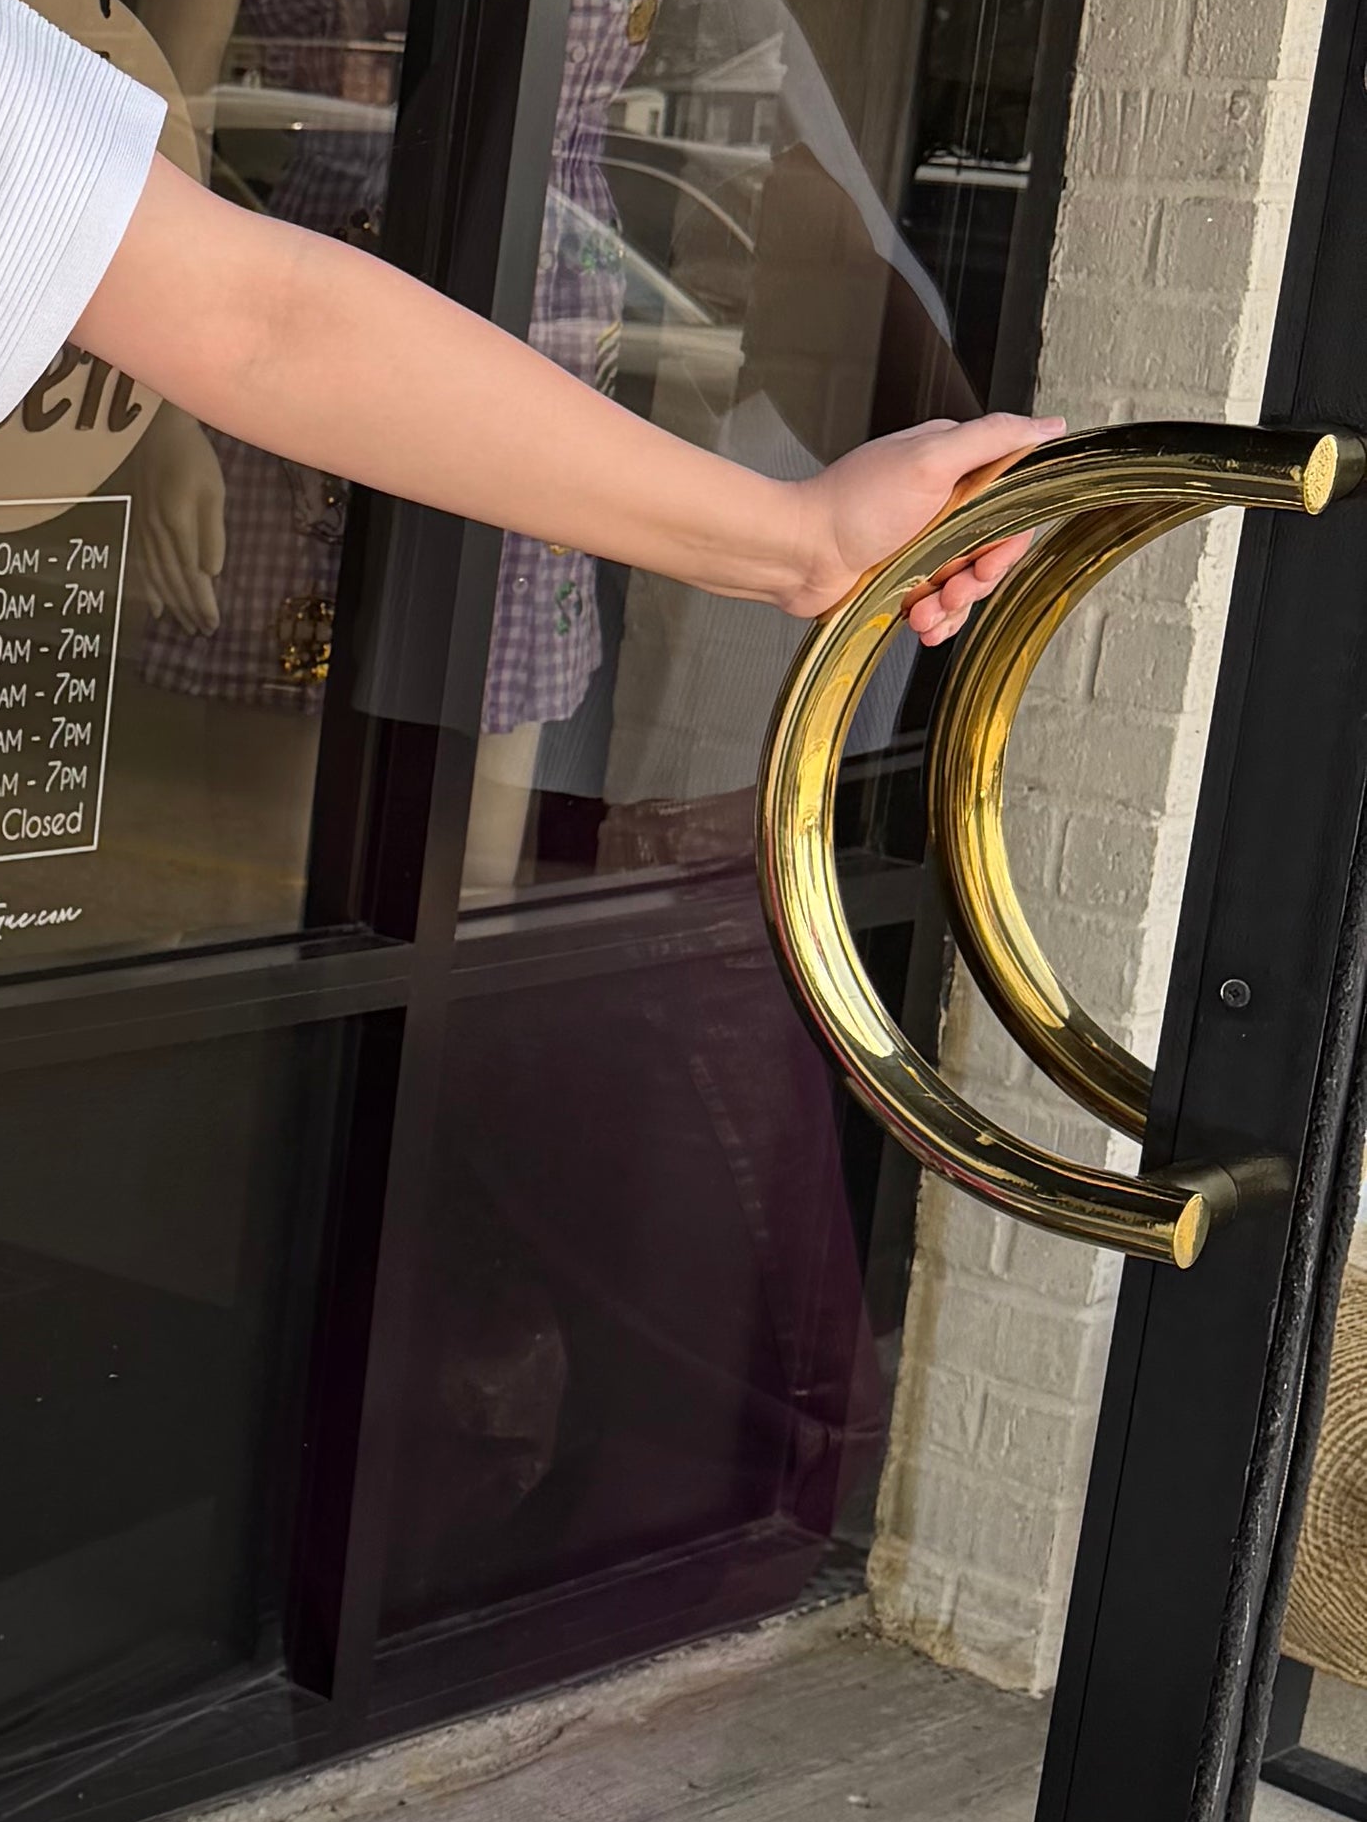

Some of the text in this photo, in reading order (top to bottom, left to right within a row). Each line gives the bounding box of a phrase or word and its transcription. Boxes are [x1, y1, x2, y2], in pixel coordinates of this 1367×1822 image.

[66, 538, 109, 571] 7PM
[62, 583, 105, 616] 7PM
[57, 628, 100, 661] 7PM
[53, 672, 96, 705] 7PM
[49, 716, 92, 749] 7PM
[45, 760, 88, 792] 7PM
[2, 801, 84, 841] Closed
